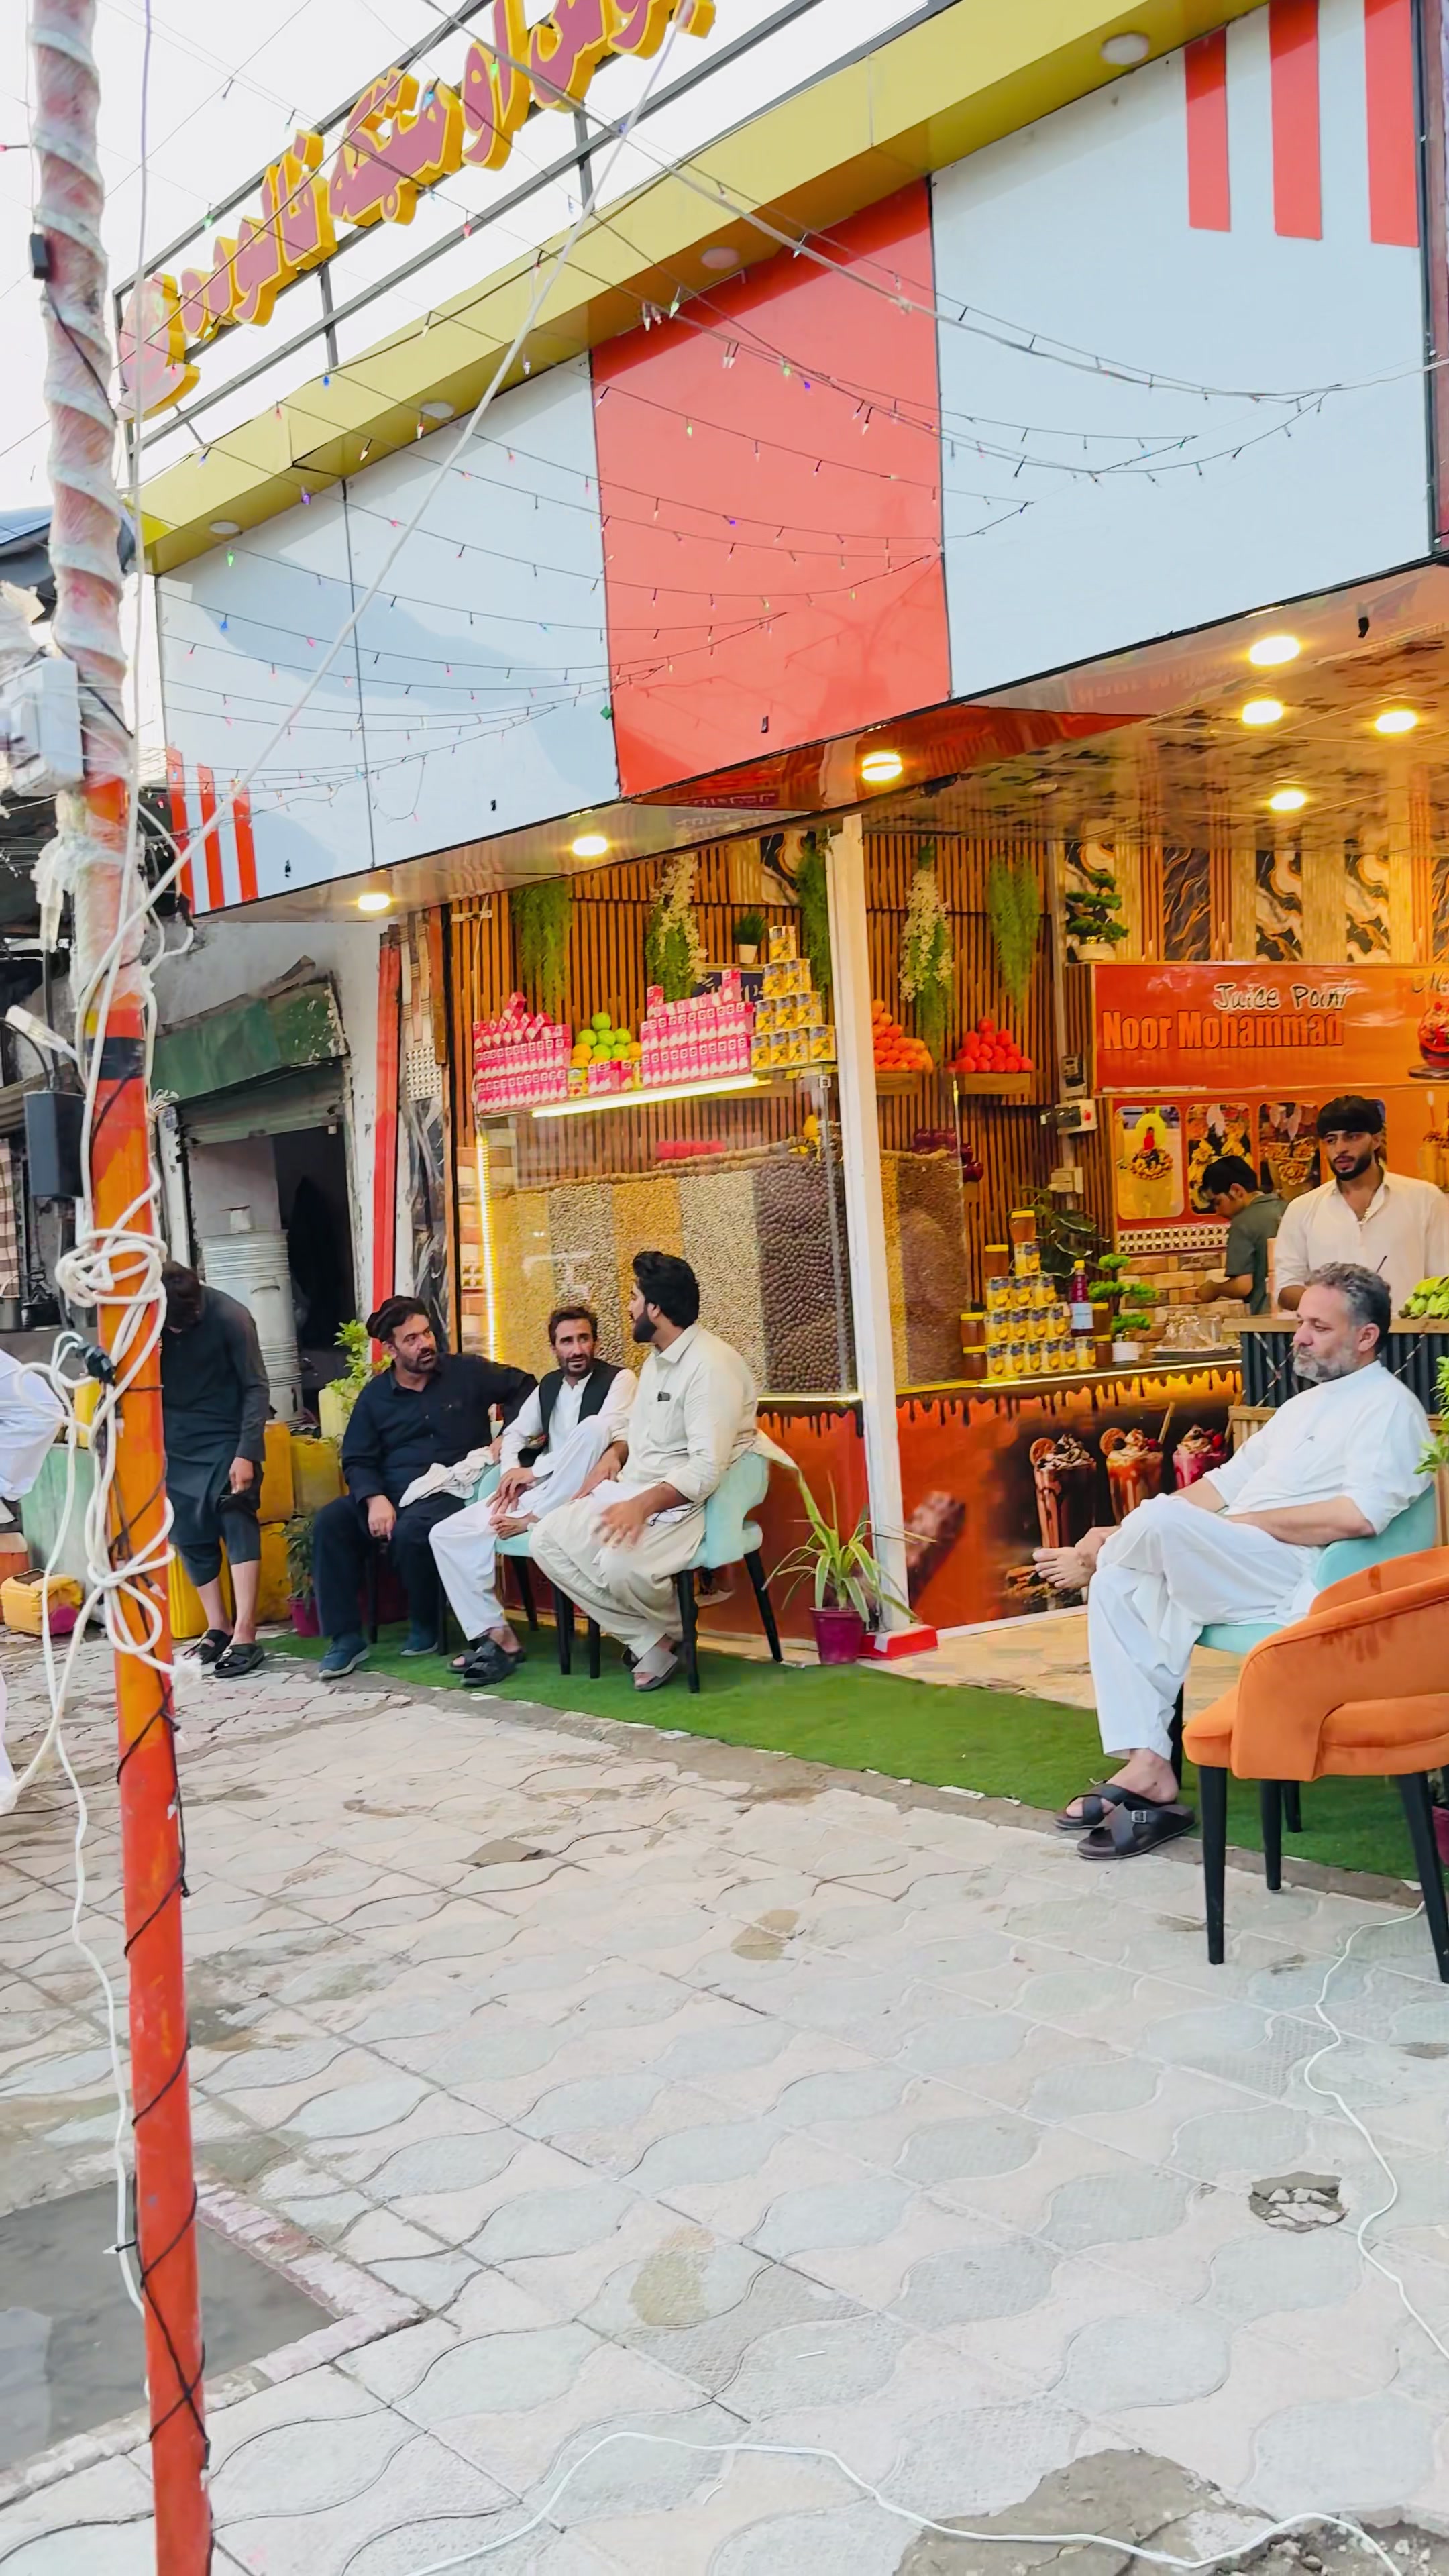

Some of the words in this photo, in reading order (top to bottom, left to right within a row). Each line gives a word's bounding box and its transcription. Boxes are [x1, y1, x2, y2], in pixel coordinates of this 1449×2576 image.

[1213, 982, 1281, 1010] Juice
[1102, 1011, 1172, 1050] Noor
[1177, 1009, 1344, 1049] Mohammad
